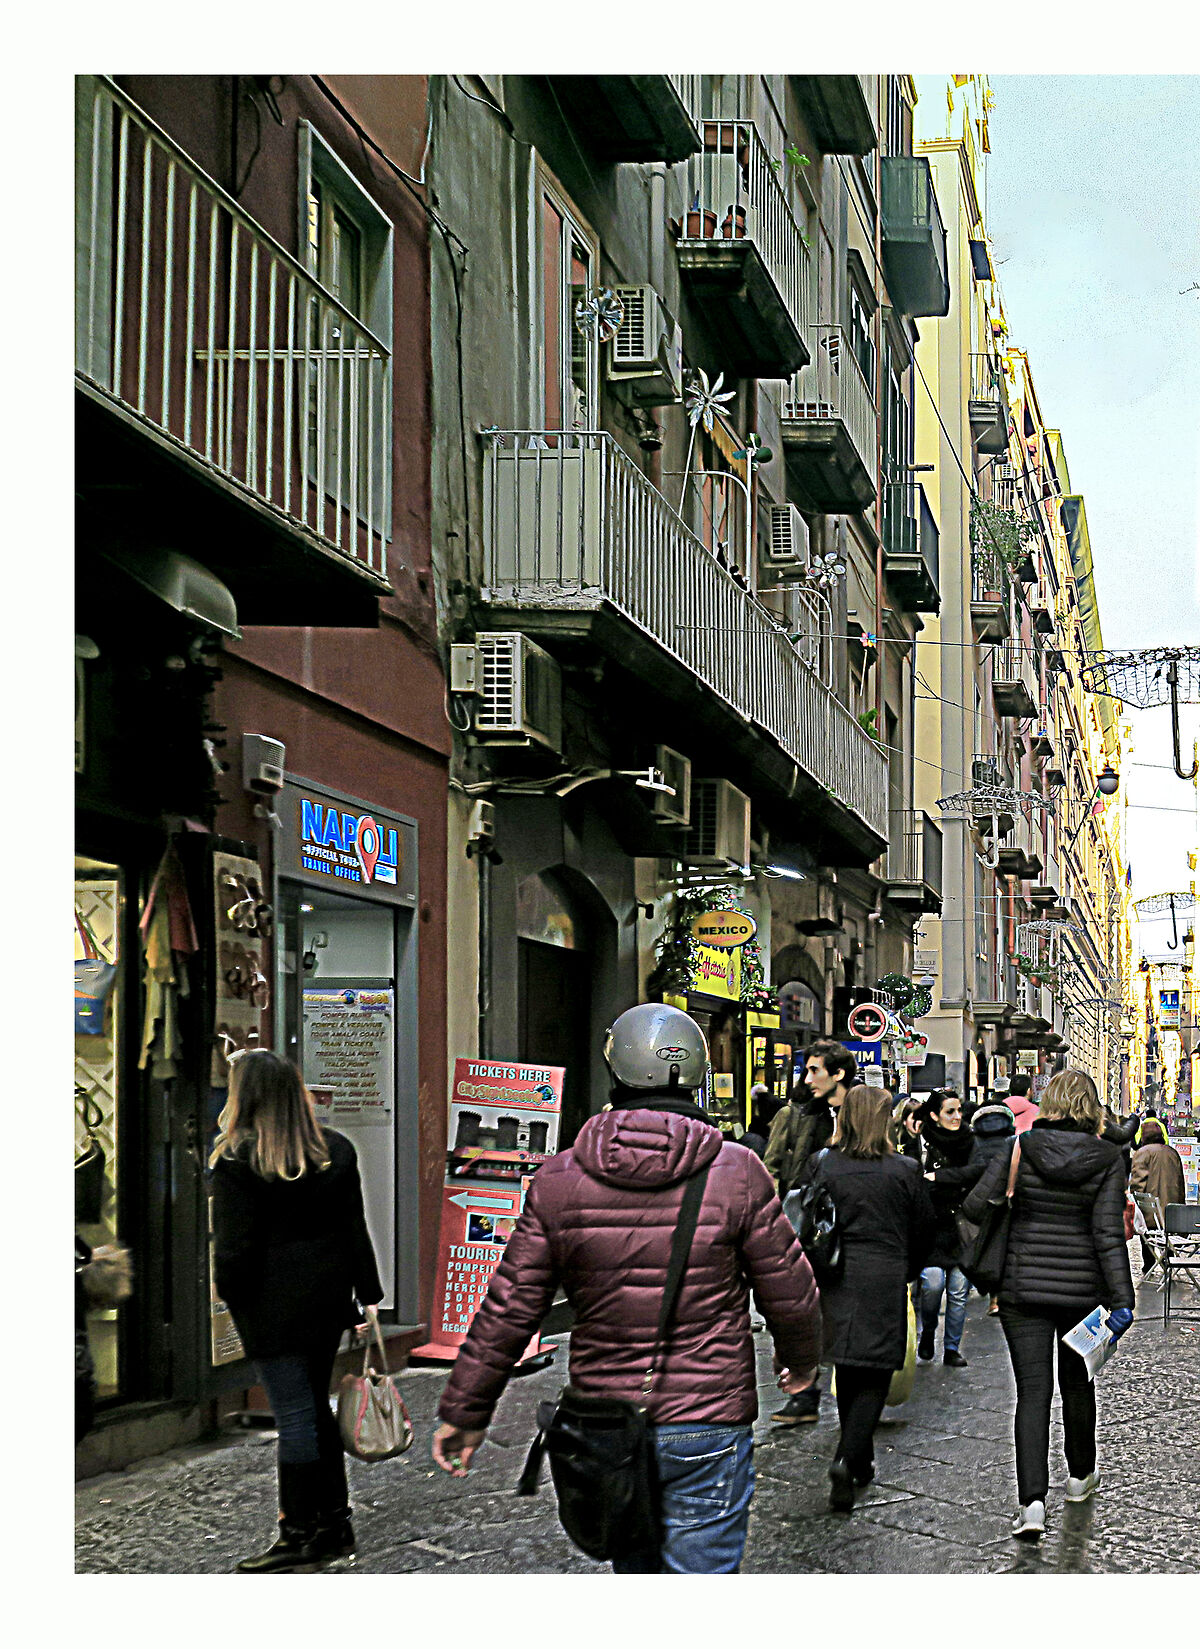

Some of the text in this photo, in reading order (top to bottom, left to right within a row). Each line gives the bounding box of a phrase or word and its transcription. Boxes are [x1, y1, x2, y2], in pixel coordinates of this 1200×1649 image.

[301, 799, 398, 867] NAPOLI
[302, 856, 331, 874] TRAVEL
[334, 865, 360, 882] OFFICE
[698, 926, 748, 935] MEXICO
[468, 1064, 551, 1083] TICKETS HERE
[446, 1271, 488, 1284] VESU
[446, 1282, 489, 1294] HERCU
[442, 1323, 469, 1334] REGGI
